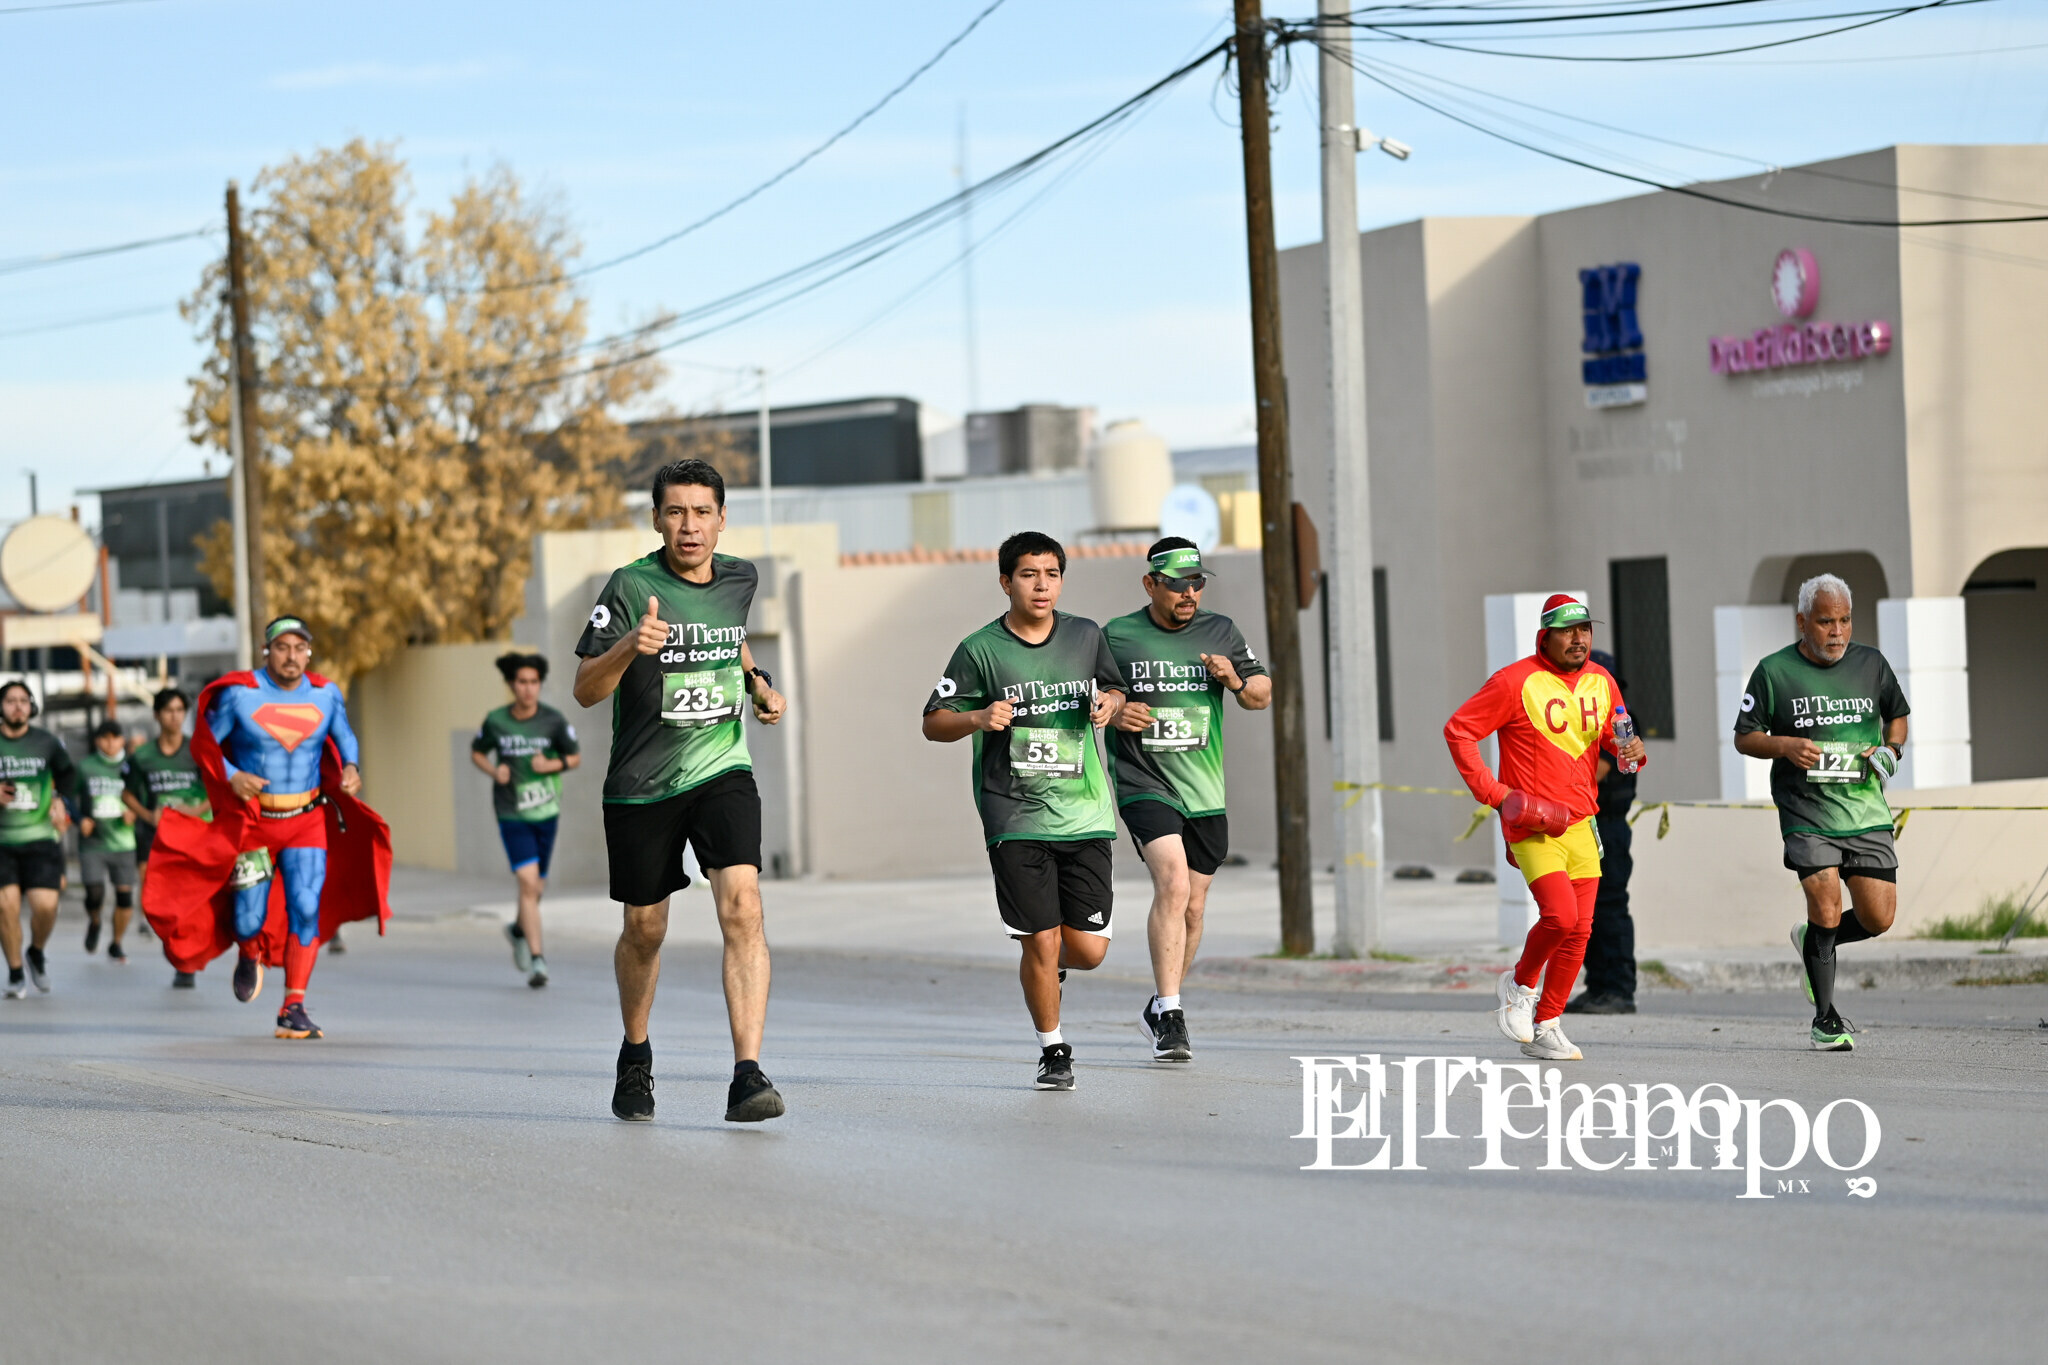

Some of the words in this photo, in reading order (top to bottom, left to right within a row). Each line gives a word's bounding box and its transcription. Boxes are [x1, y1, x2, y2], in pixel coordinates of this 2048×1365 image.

[664, 624, 685, 646] El
[660, 649, 686, 663] de
[688, 646, 738, 661] todos
[1130, 661, 1151, 679] El
[1153, 661, 1210, 681] Tiemp
[1002, 684, 1025, 704] El
[1025, 680, 1090, 701] Tiempo
[1133, 681, 1155, 692] de
[1157, 680, 1208, 692] todos
[673, 686, 724, 711] 235
[734, 679, 743, 715] MEDALLA
[1791, 696, 1811, 716] El
[1812, 695, 1873, 714] Tiempo
[1030, 700, 1080, 715] todos
[1151, 720, 1192, 739] 133
[1794, 717, 1814, 728] de
[1816, 713, 1862, 725] todos
[1201, 716, 1209, 746] MEDALLA
[1027, 742, 1059, 763] 53
[1819, 753, 1855, 772] 127
[233, 861, 256, 879] 22
